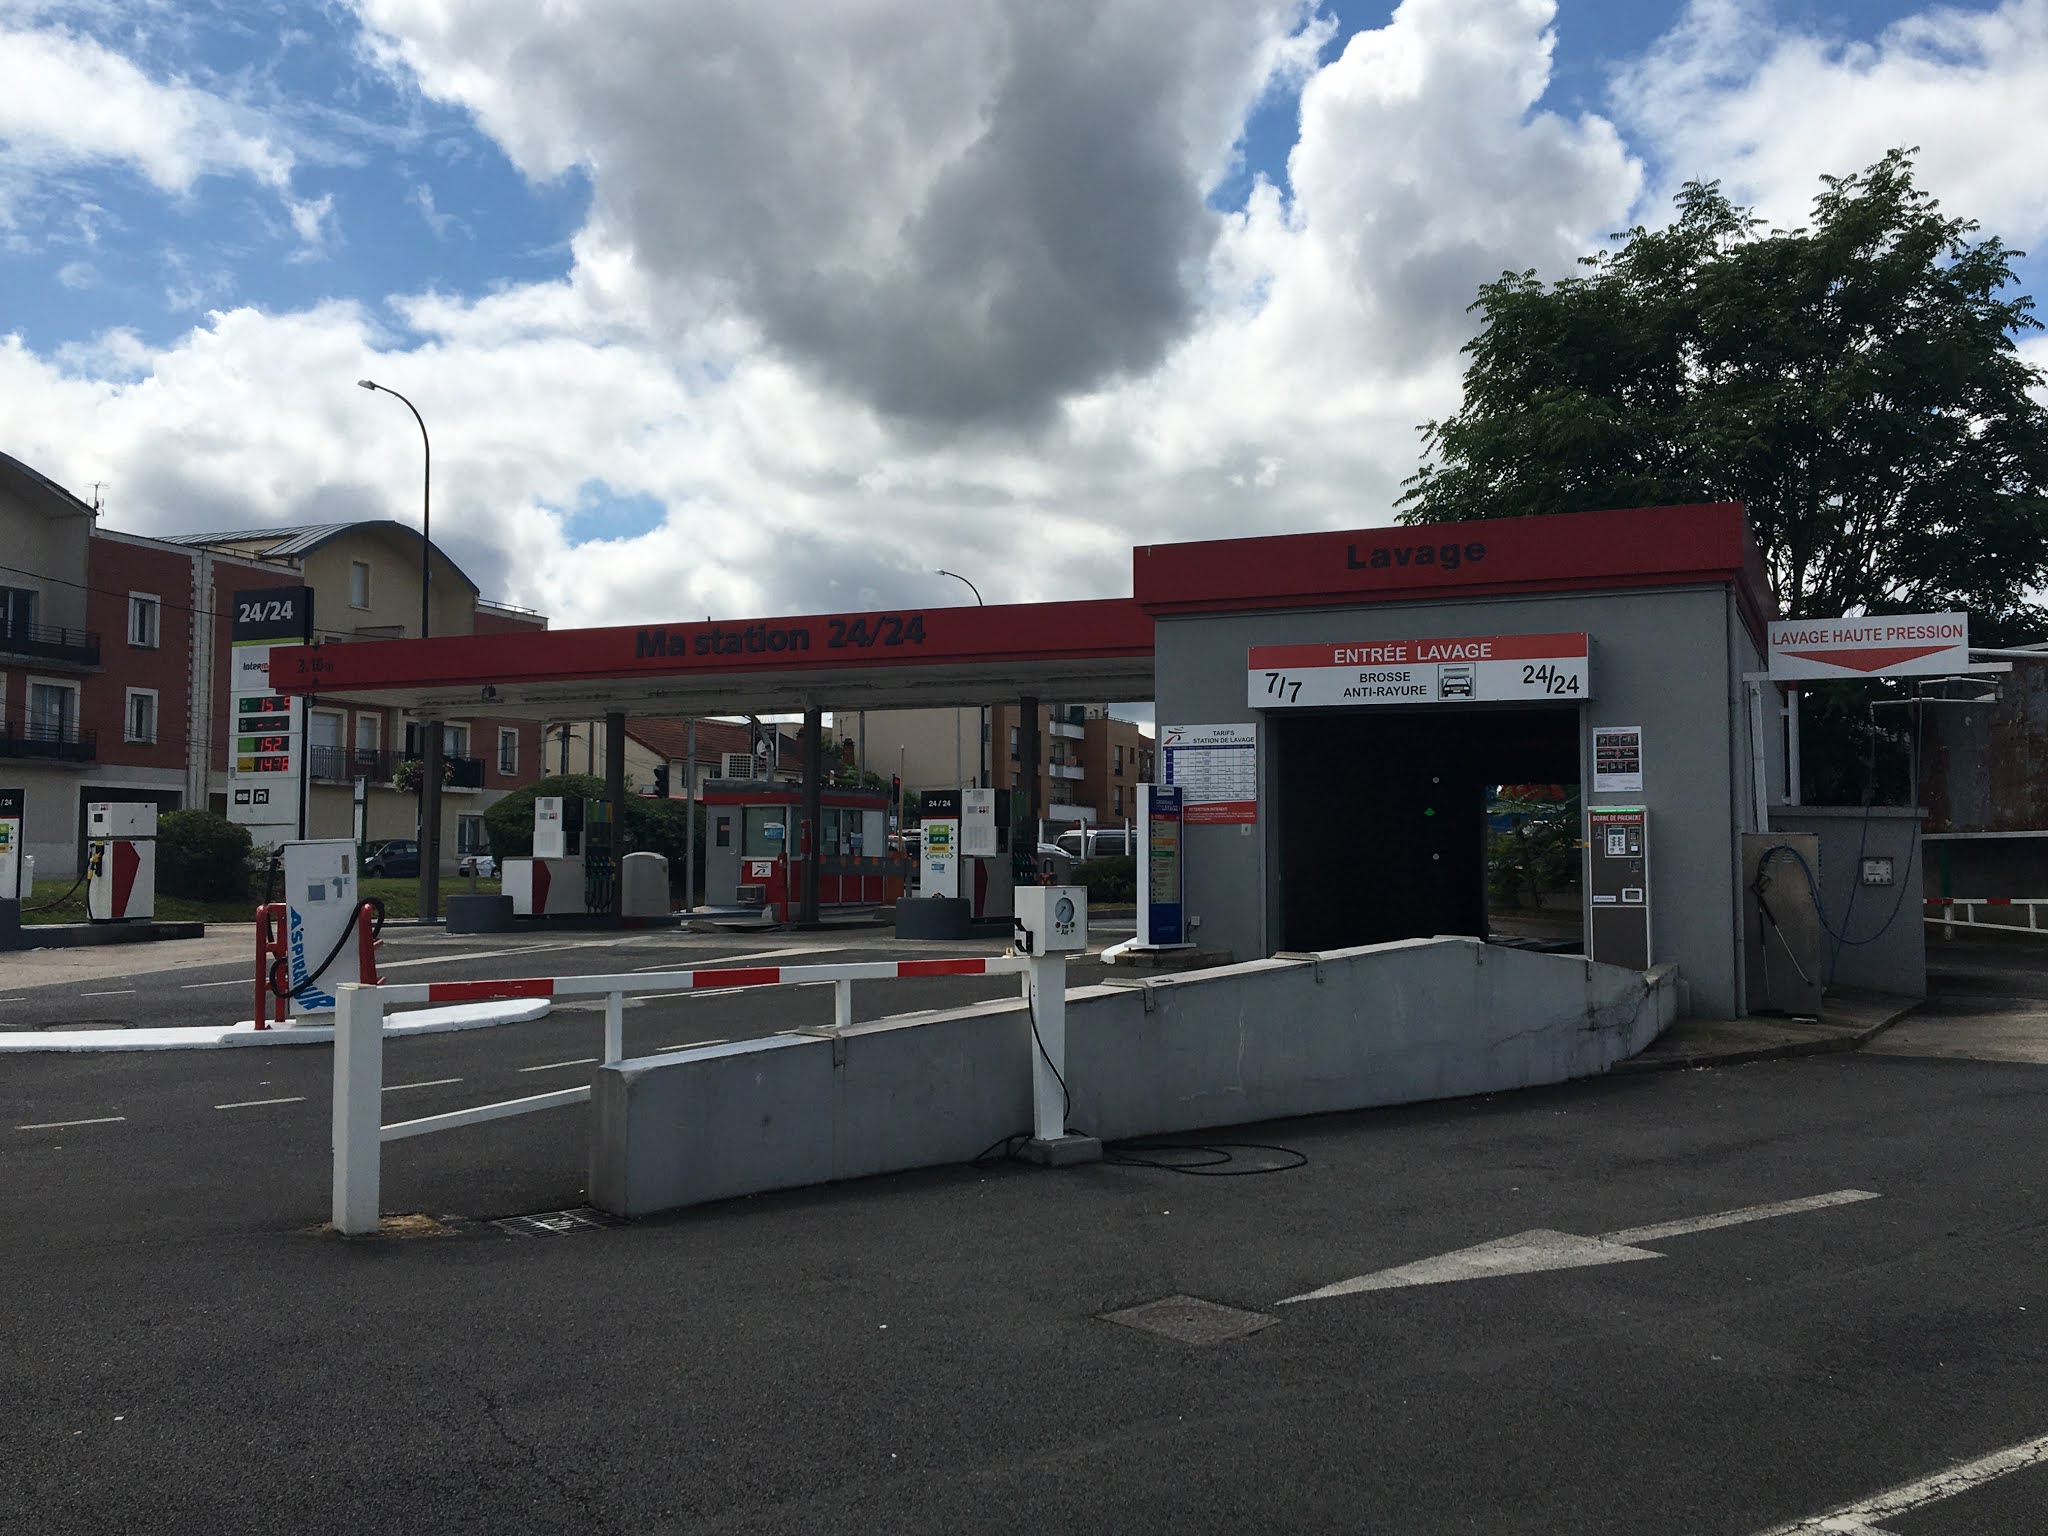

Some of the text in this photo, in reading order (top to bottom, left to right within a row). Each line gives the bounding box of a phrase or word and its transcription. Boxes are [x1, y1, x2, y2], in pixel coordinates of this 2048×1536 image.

[1347, 542, 1487, 570] Lavage
[240, 600, 294, 623] 24/24
[635, 615, 927, 658] Ma station 24/24
[1772, 624, 1963, 645] LAVAGE HAUTE PRESSION
[1333, 643, 1492, 664] ENTRÉE LAVAGE
[1264, 671, 1302, 703] 7/7
[1359, 671, 1411, 684] BROSSE
[1522, 664, 1580, 695] 24/24
[1343, 685, 1427, 698] ANTI-RAYURE
[1592, 814, 1609, 822] BORNE
[290, 906, 336, 1011] ASPIRATUR
